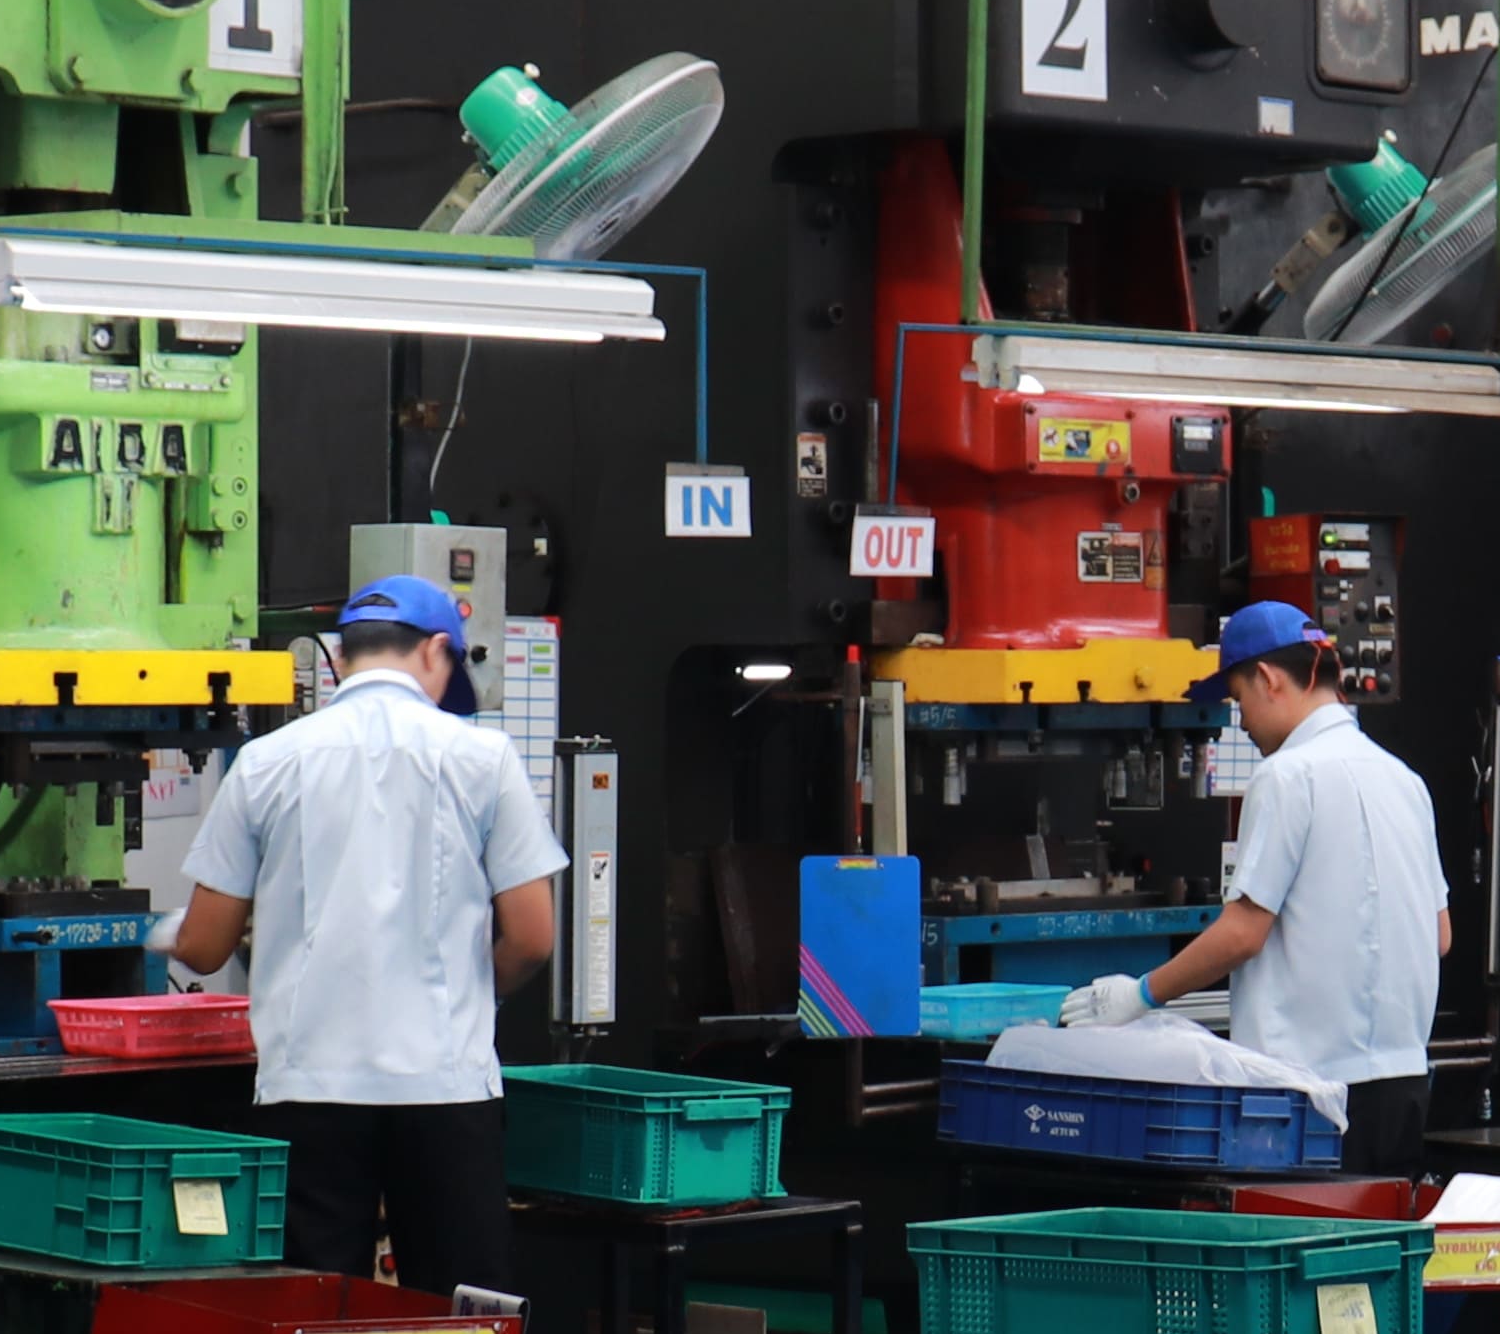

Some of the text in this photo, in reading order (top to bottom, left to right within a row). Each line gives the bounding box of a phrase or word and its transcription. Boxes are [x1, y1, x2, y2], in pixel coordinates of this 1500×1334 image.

[681, 486, 733, 527] IN
[863, 525, 924, 569] OUT
[1047, 1109, 1085, 1126] SANSHIN
